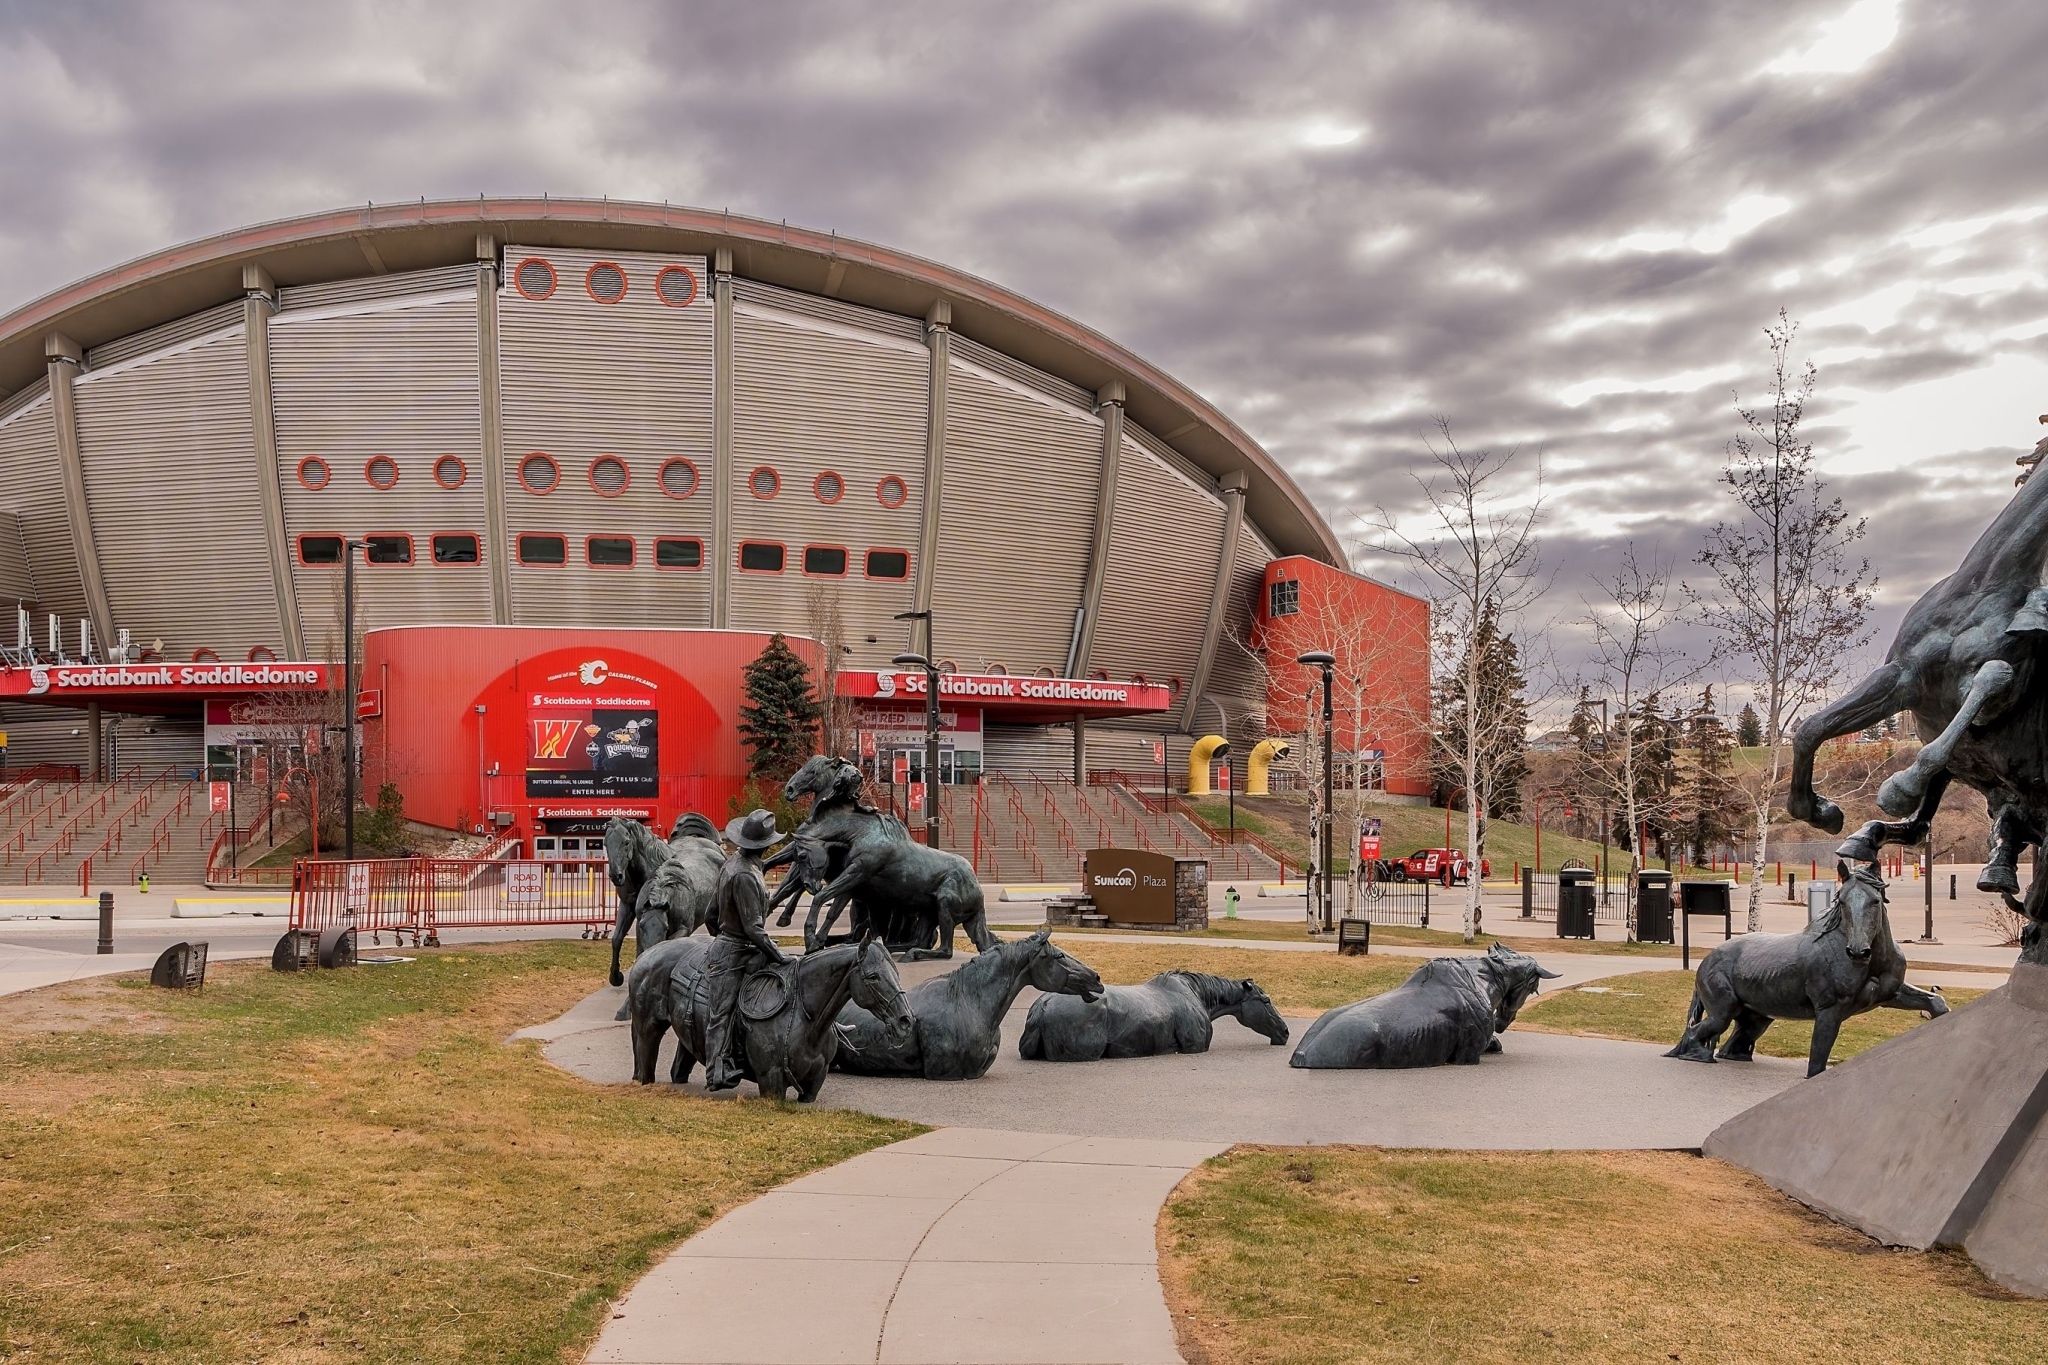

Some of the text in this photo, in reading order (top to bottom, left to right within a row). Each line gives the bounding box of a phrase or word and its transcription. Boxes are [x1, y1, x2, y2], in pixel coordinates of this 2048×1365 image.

[57, 666, 318, 687] Scotiabank Saddledome
[608, 671, 658, 690] CALGARY FLAMES
[905, 676, 1128, 701] Sctiabank Saddledome
[543, 696, 651, 706] Scotiabank Saddledome
[880, 713, 906, 723] RED
[534, 720, 582, 758] W
[546, 807, 649, 816] Scotiabank Saddledome
[513, 874, 537, 882] ROAD
[1094, 875, 1167, 887] SUNCOR Plaza
[510, 885, 542, 893] CLOSED
